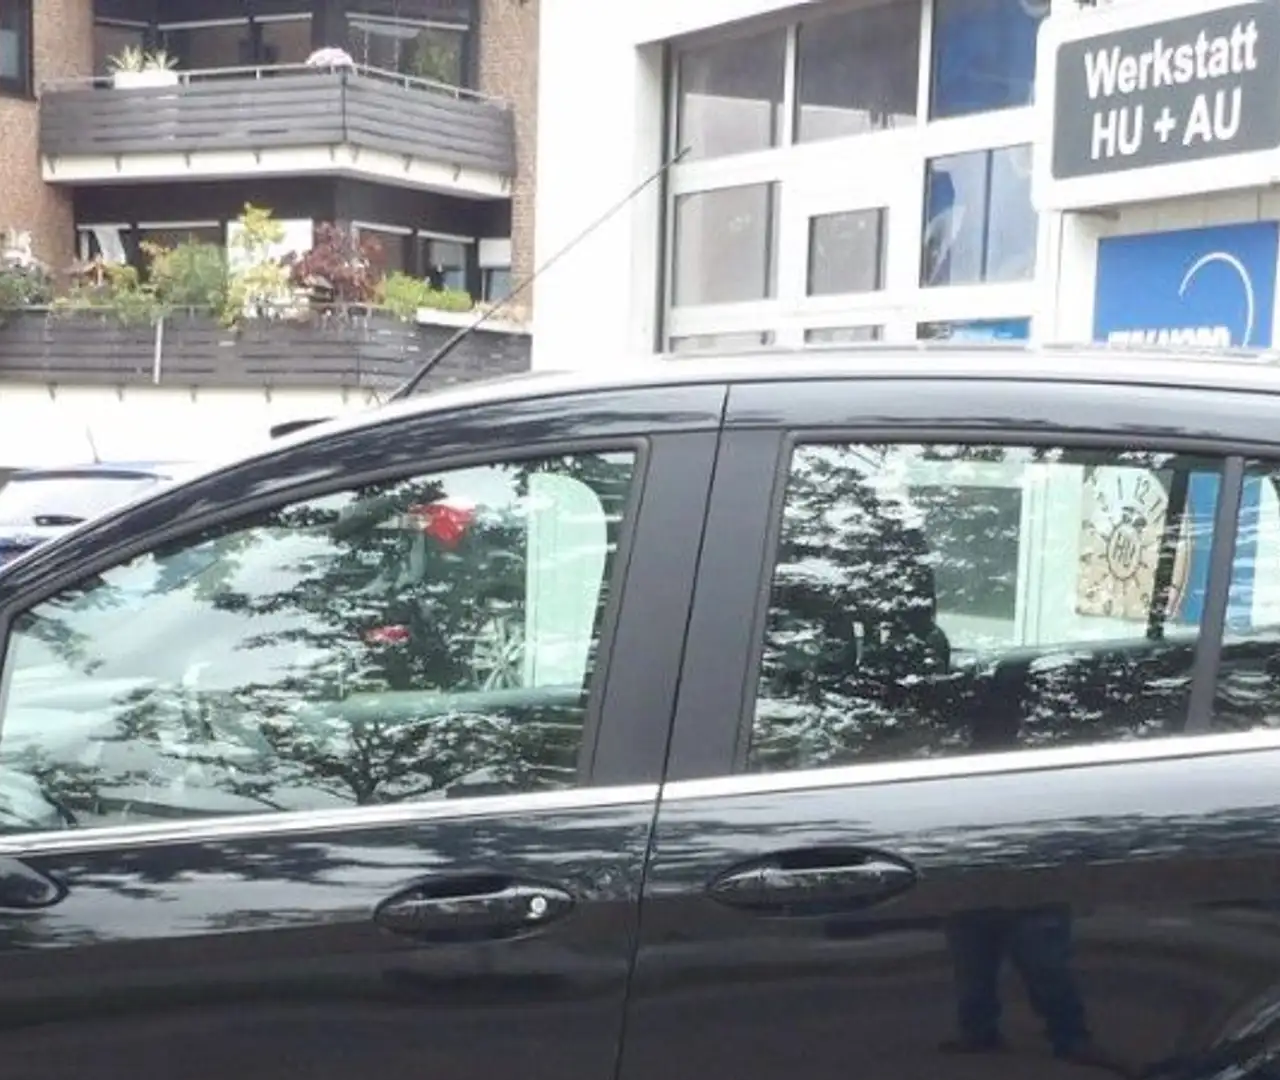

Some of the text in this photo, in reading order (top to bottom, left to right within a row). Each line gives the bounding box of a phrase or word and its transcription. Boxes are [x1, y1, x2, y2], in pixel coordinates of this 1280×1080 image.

[1084, 19, 1258, 99] Werkstatt
[1090, 86, 1242, 160] HU + AU
